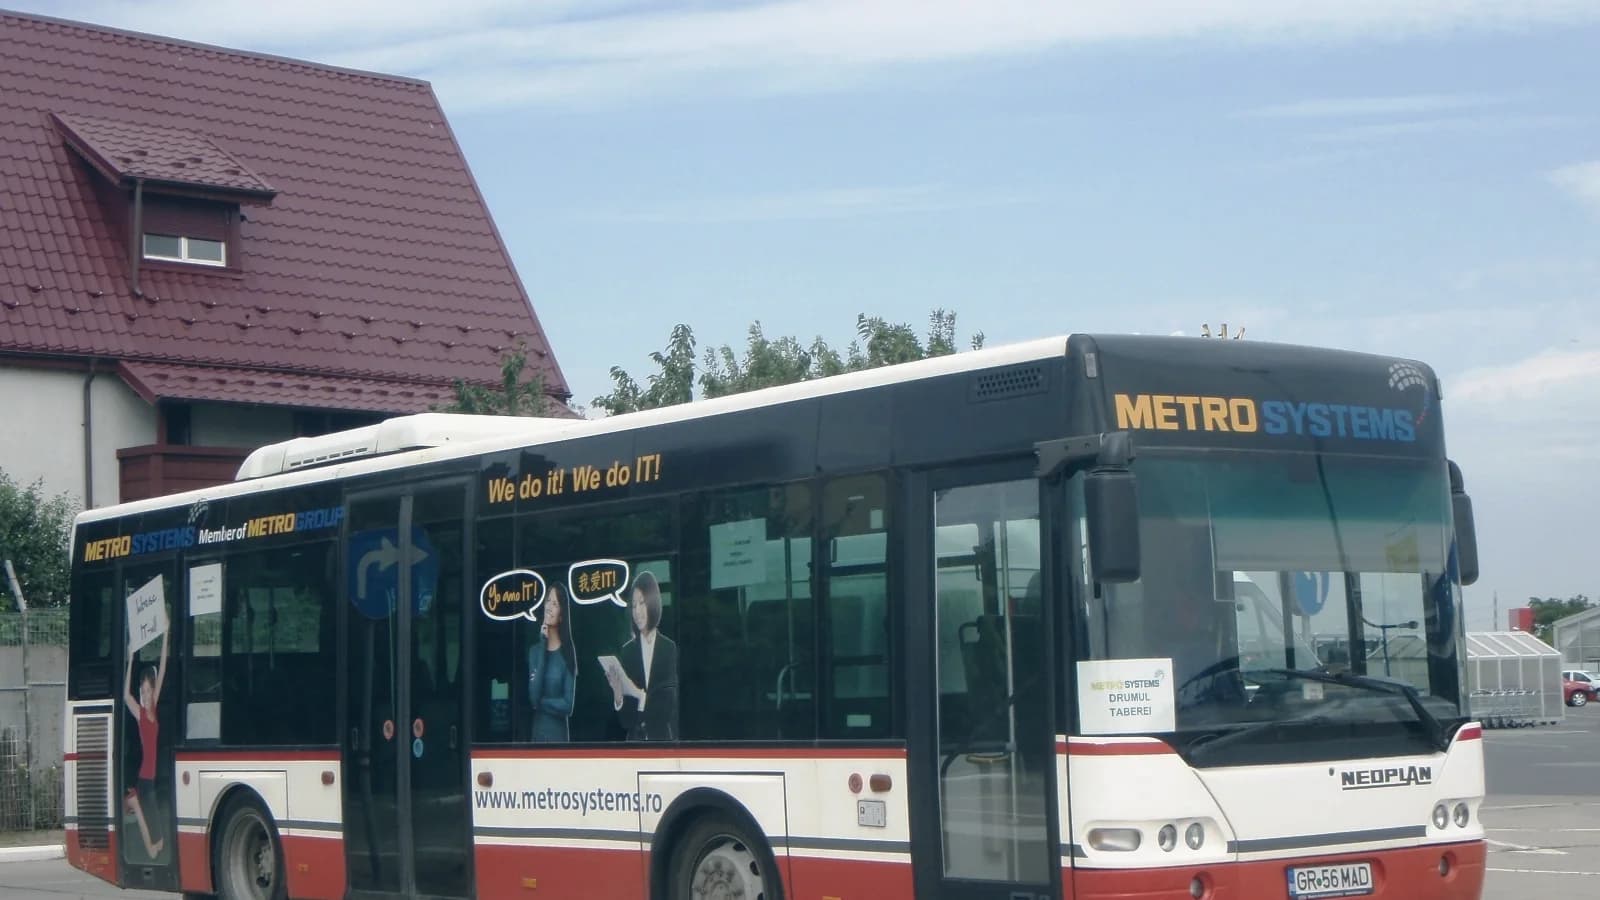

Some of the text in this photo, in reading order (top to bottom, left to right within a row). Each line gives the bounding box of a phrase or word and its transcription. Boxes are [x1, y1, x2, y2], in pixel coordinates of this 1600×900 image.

[1114, 393, 1416, 441] METRO SYSTEMS
[488, 454, 662, 503] We do it! We do IT!
[198, 525, 237, 544] Member
[236, 522, 248, 539] of
[488, 581, 537, 611] Yo amo IT!
[1124, 680, 1160, 689] SYSTEMS
[1109, 693, 1151, 703] DRUMUL
[1109, 707, 1152, 717] TABEREI
[1341, 766, 1432, 787] NEOPLAN
[475, 787, 662, 816] www.metrosystems.ro
